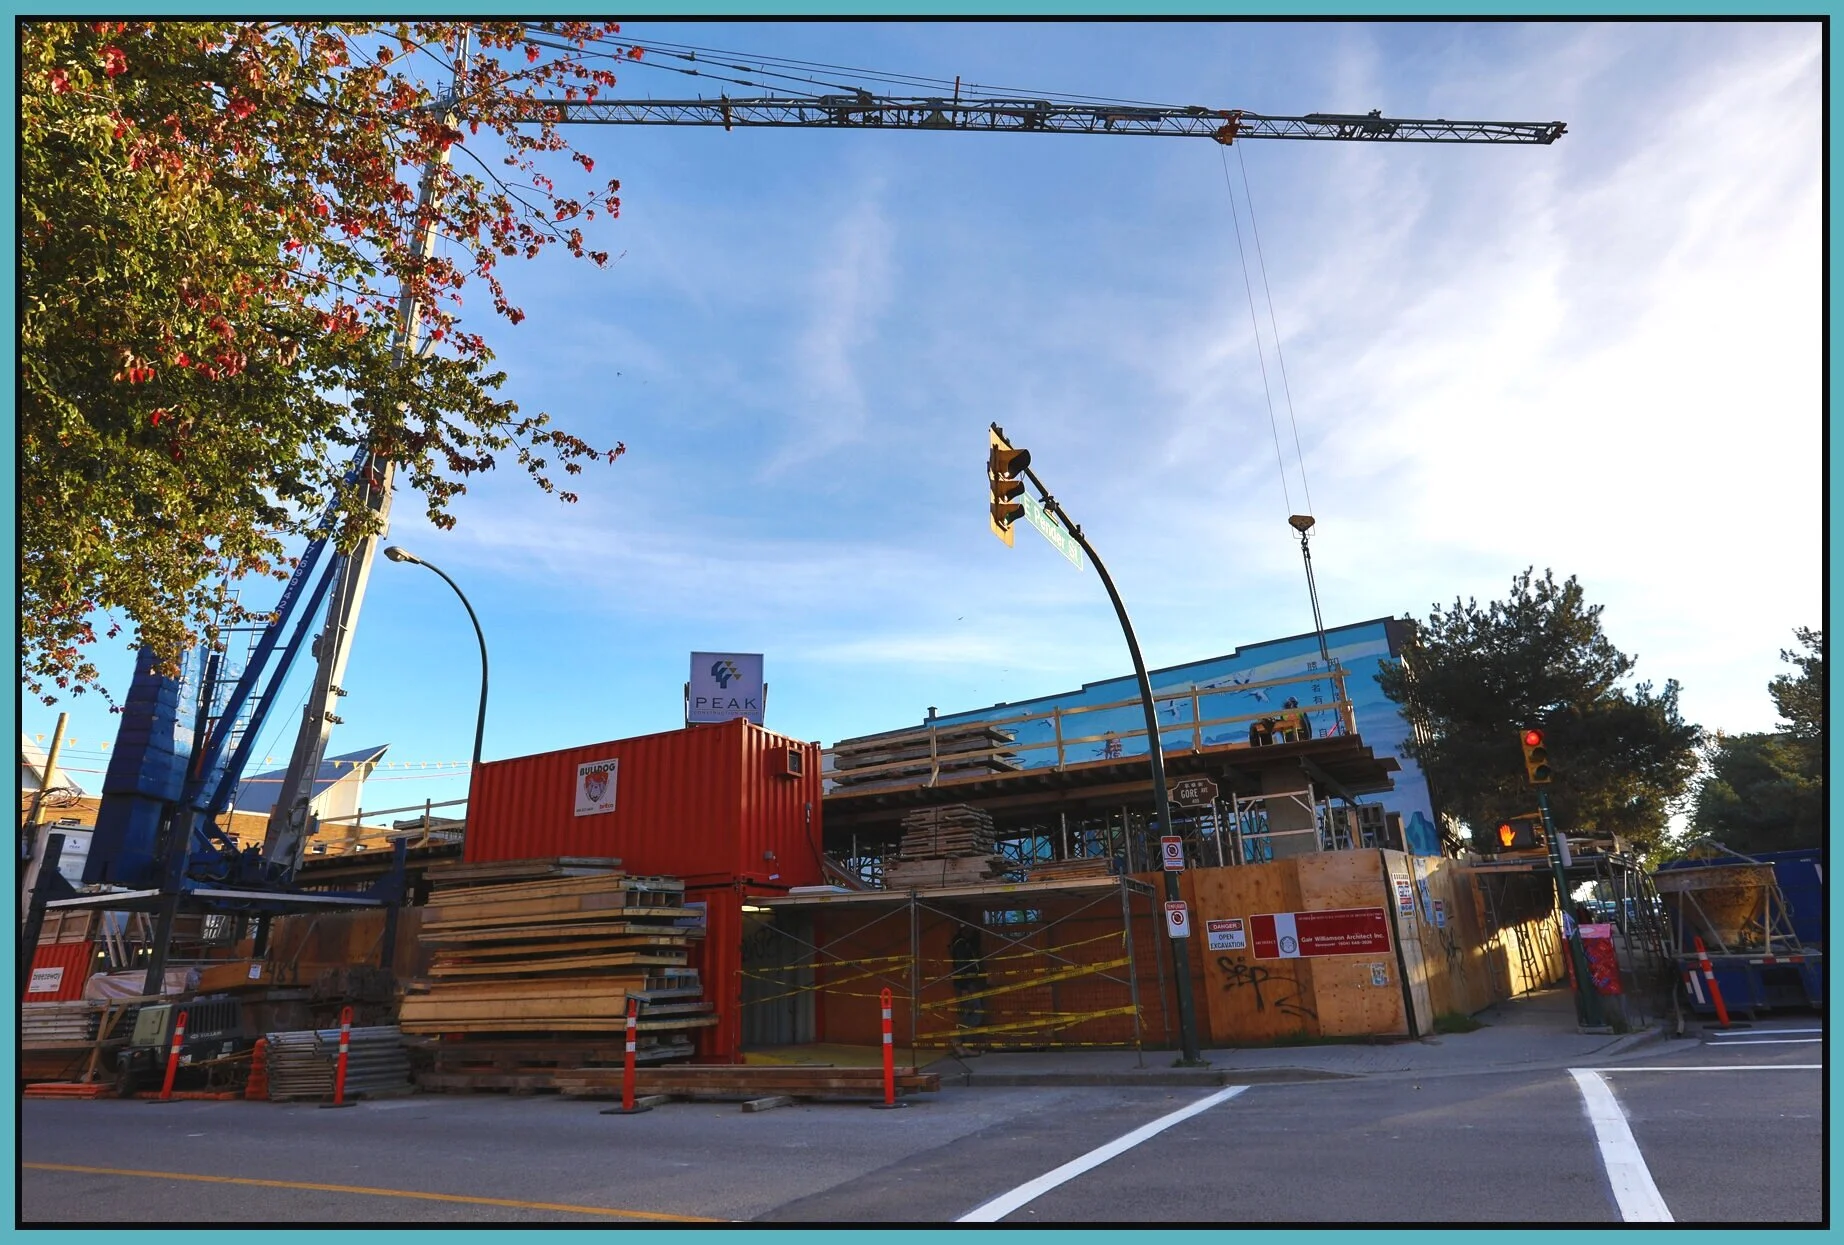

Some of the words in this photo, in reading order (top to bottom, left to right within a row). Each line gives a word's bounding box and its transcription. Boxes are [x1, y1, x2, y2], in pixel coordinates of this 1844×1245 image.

[1024, 496, 1031, 518] E
[1034, 506, 1065, 549] Pender
[1069, 539, 1077, 560] St
[695, 697, 758, 710] PEAK
[579, 762, 616, 776] BULLDOG
[1180, 788, 1199, 800] GORE
[1212, 922, 1239, 931] DANGER
[1218, 933, 1234, 941] OPEN
[1300, 935, 1313, 943] Gair
[1314, 934, 1345, 942] Williamson
[1346, 932, 1373, 941] Architect
[1373, 931, 1385, 939] Inc.
[1210, 940, 1245, 950] EXCAVATION
